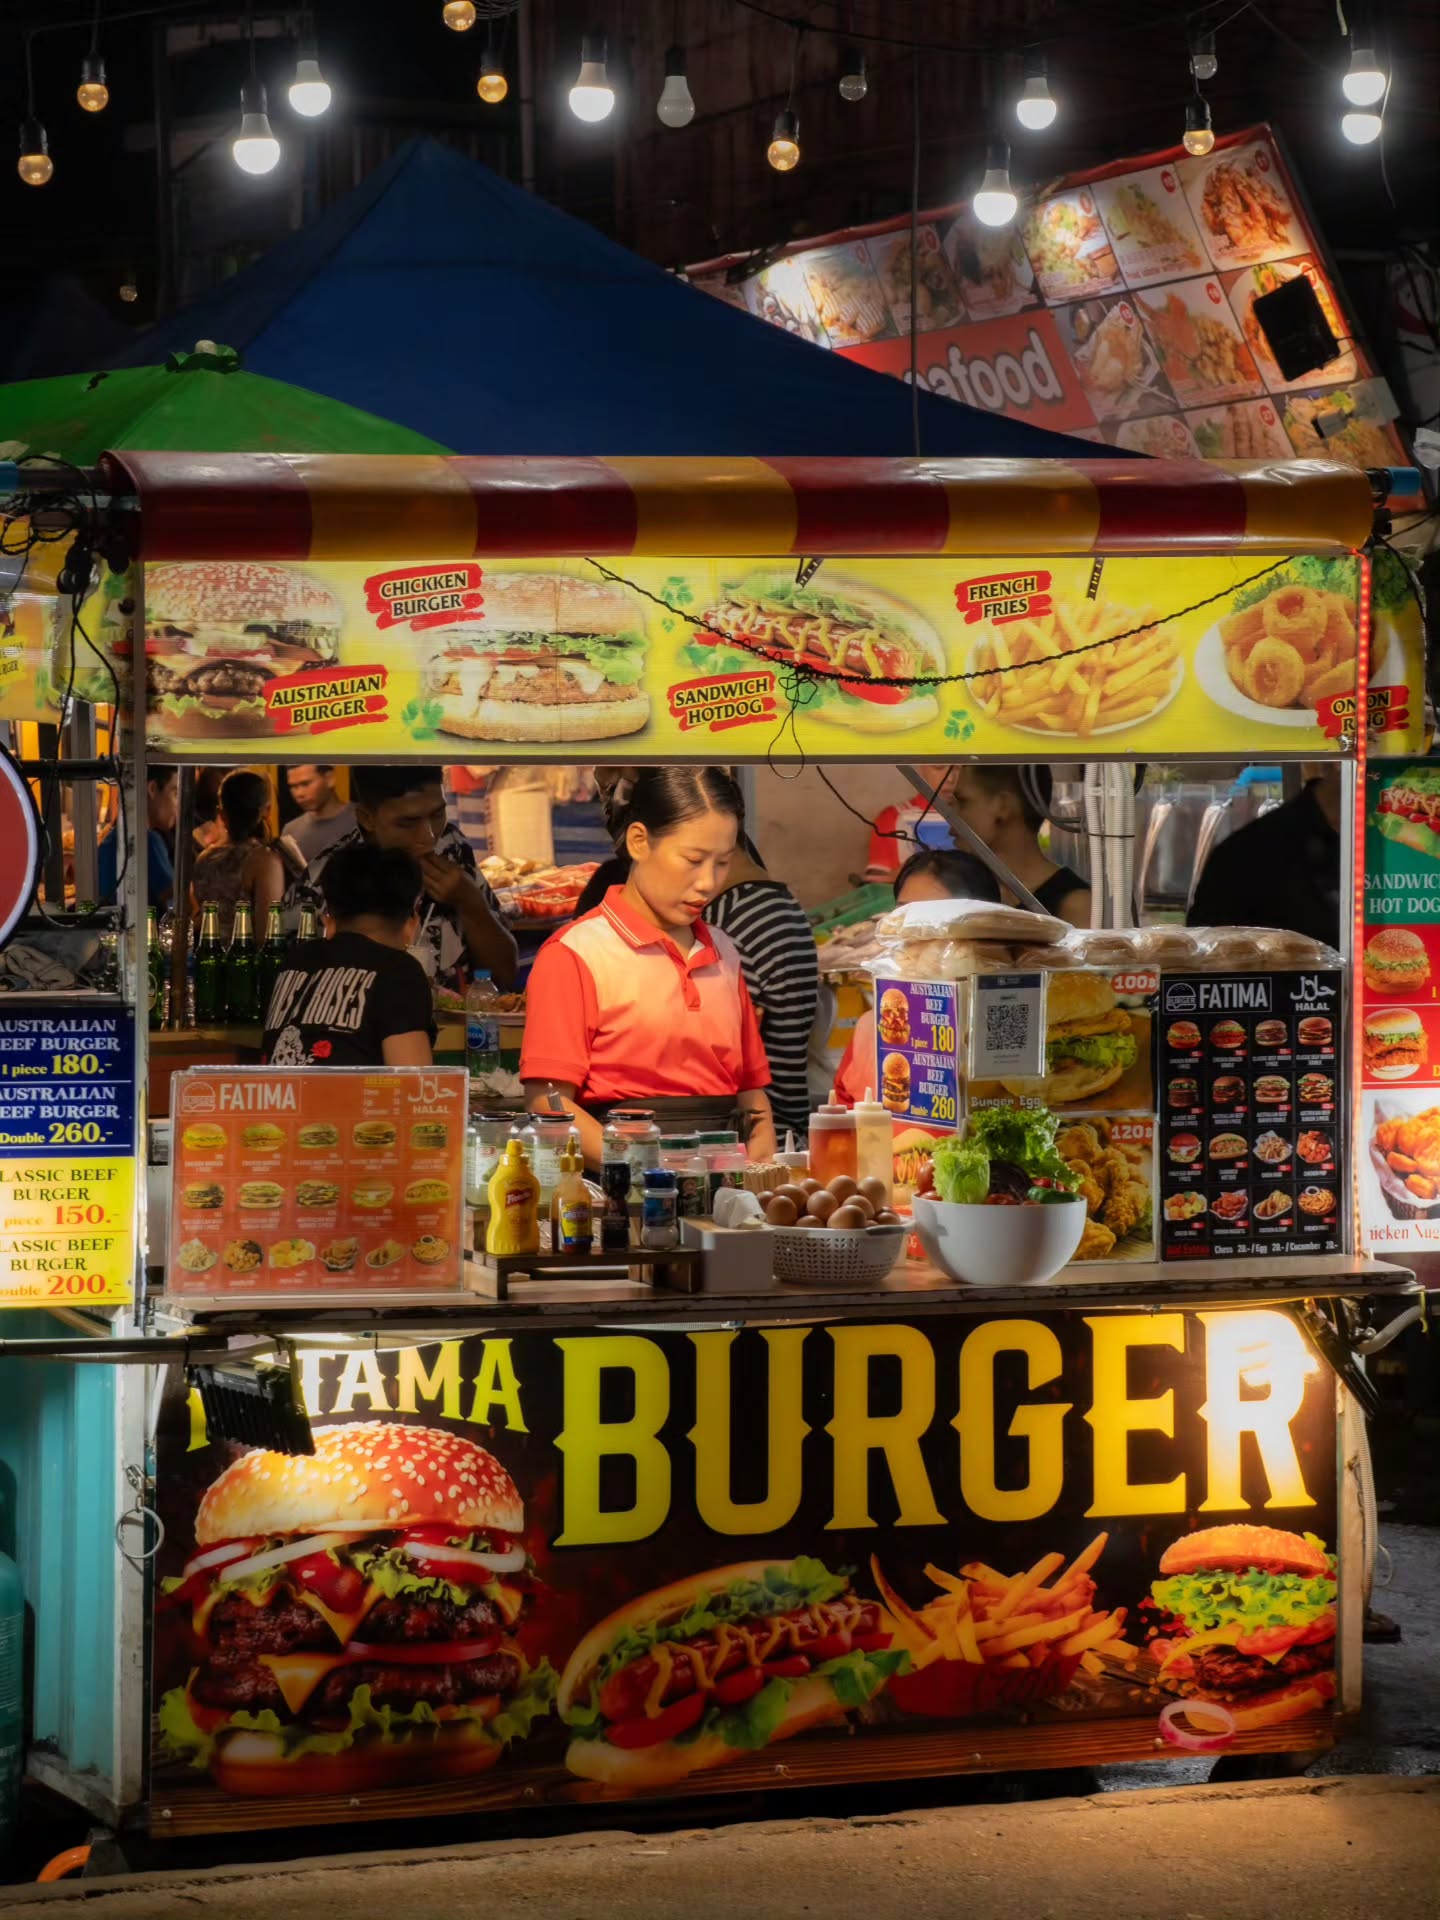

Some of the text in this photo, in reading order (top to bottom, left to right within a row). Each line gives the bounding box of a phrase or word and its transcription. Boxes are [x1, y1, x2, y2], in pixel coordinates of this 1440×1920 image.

[904, 329, 1064, 409] afood
[382, 572, 467, 598] CHICKKEN
[969, 577, 1036, 601] FRENCH
[393, 594, 462, 617] BURGER
[983, 598, 1029, 618] FRIES
[272, 676, 381, 707] AUSTRALIAN
[676, 678, 769, 706] SANDWICH
[293, 700, 366, 724] BURGER
[687, 699, 762, 724] HOTDOG
[1333, 691, 1390, 714] ONON
[1343, 712, 1385, 732] RNG
[1363, 873, 1440, 890] SANDWIC
[1369, 897, 1440, 914] HOT DOG
[301, 966, 377, 1031] ROSES
[910, 984, 954, 998] AUSTRALIAN
[1199, 982, 1269, 1009] FATIMA
[925, 998, 944, 1011] BEEF
[1295, 1002, 1331, 1012] HALAL
[920, 1012, 950, 1026] BURGER
[0, 1037, 120, 1052] EEF BURGER
[931, 1025, 955, 1052] 180
[2, 1054, 112, 1078] 1 piece 180.-
[912, 1053, 955, 1069] AUSTRALIAN
[927, 1069, 945, 1083] BEEF
[219, 1083, 297, 1110] FATIMA
[919, 1082, 949, 1096] BURGER
[0, 1104, 120, 1119] EEF BURGER
[413, 1105, 449, 1114] HALAL
[931, 1095, 955, 1121] 260
[1019, 1095, 1041, 1109] Egg
[48, 1121, 113, 1143] 260.-
[0, 1168, 118, 1182] LASSIC BEEF
[13, 1187, 90, 1202] BURGER
[4, 1204, 120, 1229] piece 150.-
[0, 1238, 114, 1252] LASSIC BEEF
[1255, 1243, 1268, 1254] Egg
[10, 1257, 87, 1271] BURGER
[0, 1274, 121, 1297] ouble 200.-
[186, 1309, 1318, 1546] TAMA BURGER
